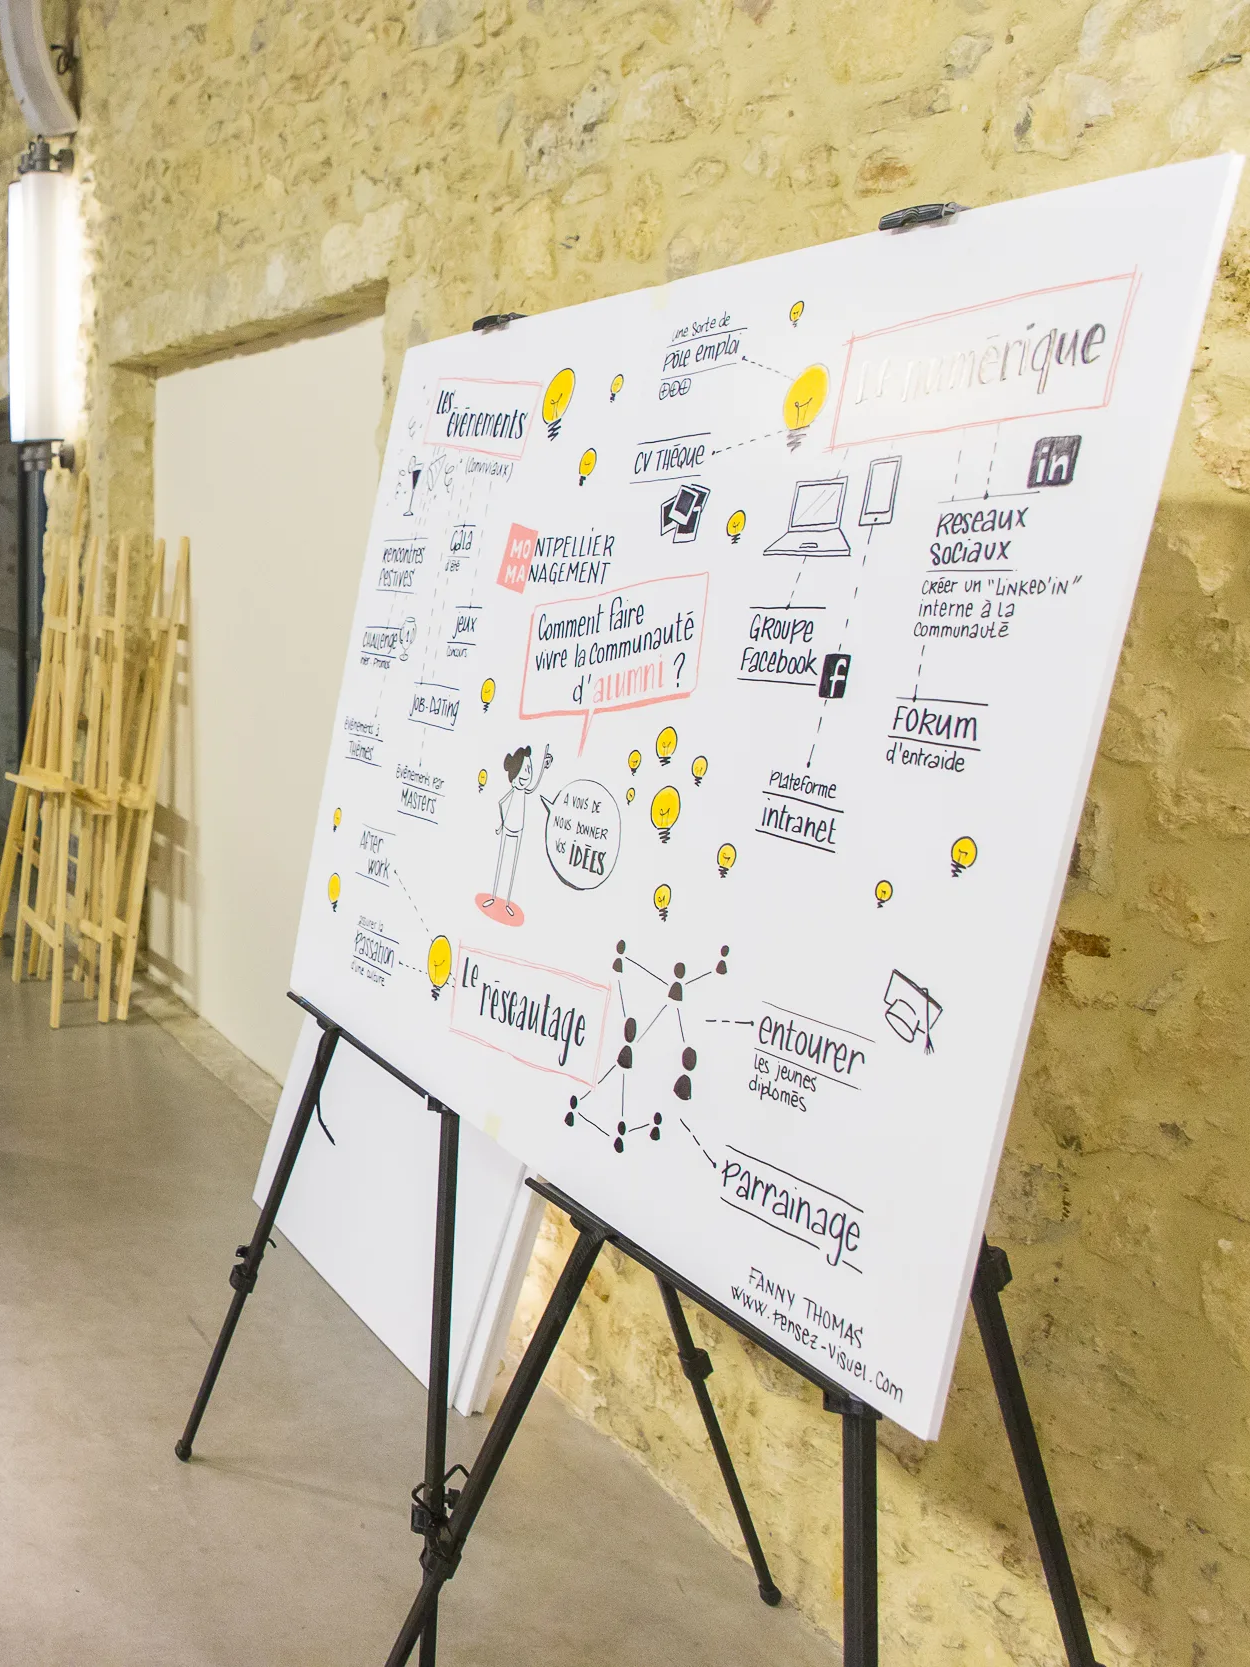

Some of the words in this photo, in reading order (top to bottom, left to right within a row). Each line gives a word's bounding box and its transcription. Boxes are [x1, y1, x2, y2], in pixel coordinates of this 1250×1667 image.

[672, 326, 689, 342] une
[718, 311, 731, 327] de
[695, 332, 742, 362] emploi
[436, 389, 456, 415] Les
[634, 450, 653, 475] CV
[1034, 445, 1071, 484] in
[504, 561, 611, 585] MANAGEMENT
[964, 579, 981, 594] un
[538, 603, 604, 641] Comment
[609, 596, 644, 632] faire
[918, 598, 973, 618] interne
[981, 599, 992, 618] à
[997, 601, 1015, 618] la
[452, 611, 477, 639] jeux
[535, 648, 567, 671] vivre
[574, 643, 585, 668] la
[673, 652, 686, 688] ?
[740, 646, 818, 676] Facebook
[829, 658, 848, 697] f
[886, 741, 966, 773] d'entraide
[572, 796, 589, 810] VOUS
[592, 800, 602, 814] DE
[553, 815, 572, 831] NOUS
[576, 821, 608, 840] DONNER
[761, 798, 837, 845] intranet
[367, 857, 391, 879] work
[758, 1015, 866, 1075] entourer
[774, 1061, 817, 1092] jeunes
[748, 1266, 795, 1311] FANNY
[802, 1296, 863, 1349] THOMAS
